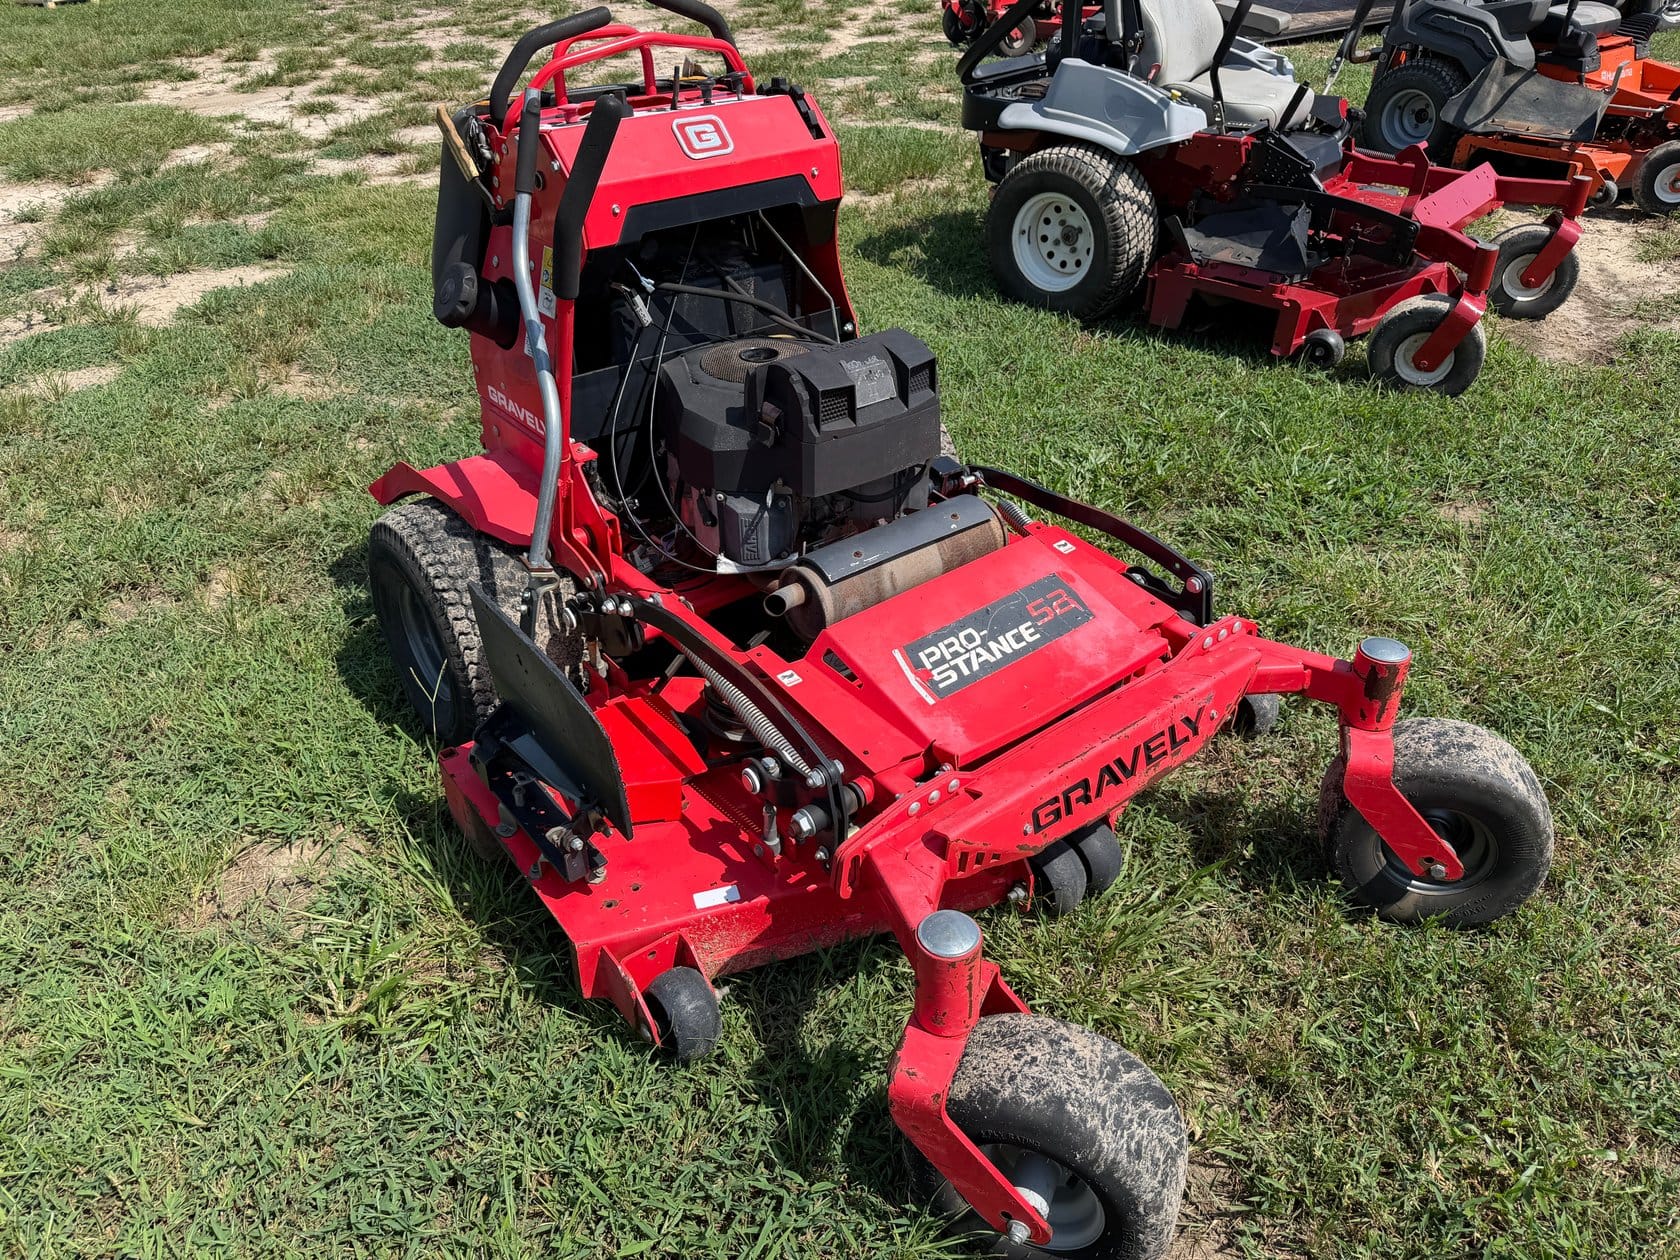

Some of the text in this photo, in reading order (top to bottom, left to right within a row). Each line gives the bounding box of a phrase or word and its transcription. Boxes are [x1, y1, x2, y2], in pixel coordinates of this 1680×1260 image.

[684, 123, 722, 150] G
[1026, 588, 1084, 627] 52
[918, 627, 988, 670] PRO-
[930, 621, 1041, 689] STANCE
[1031, 705, 1206, 835] GRAVELY
